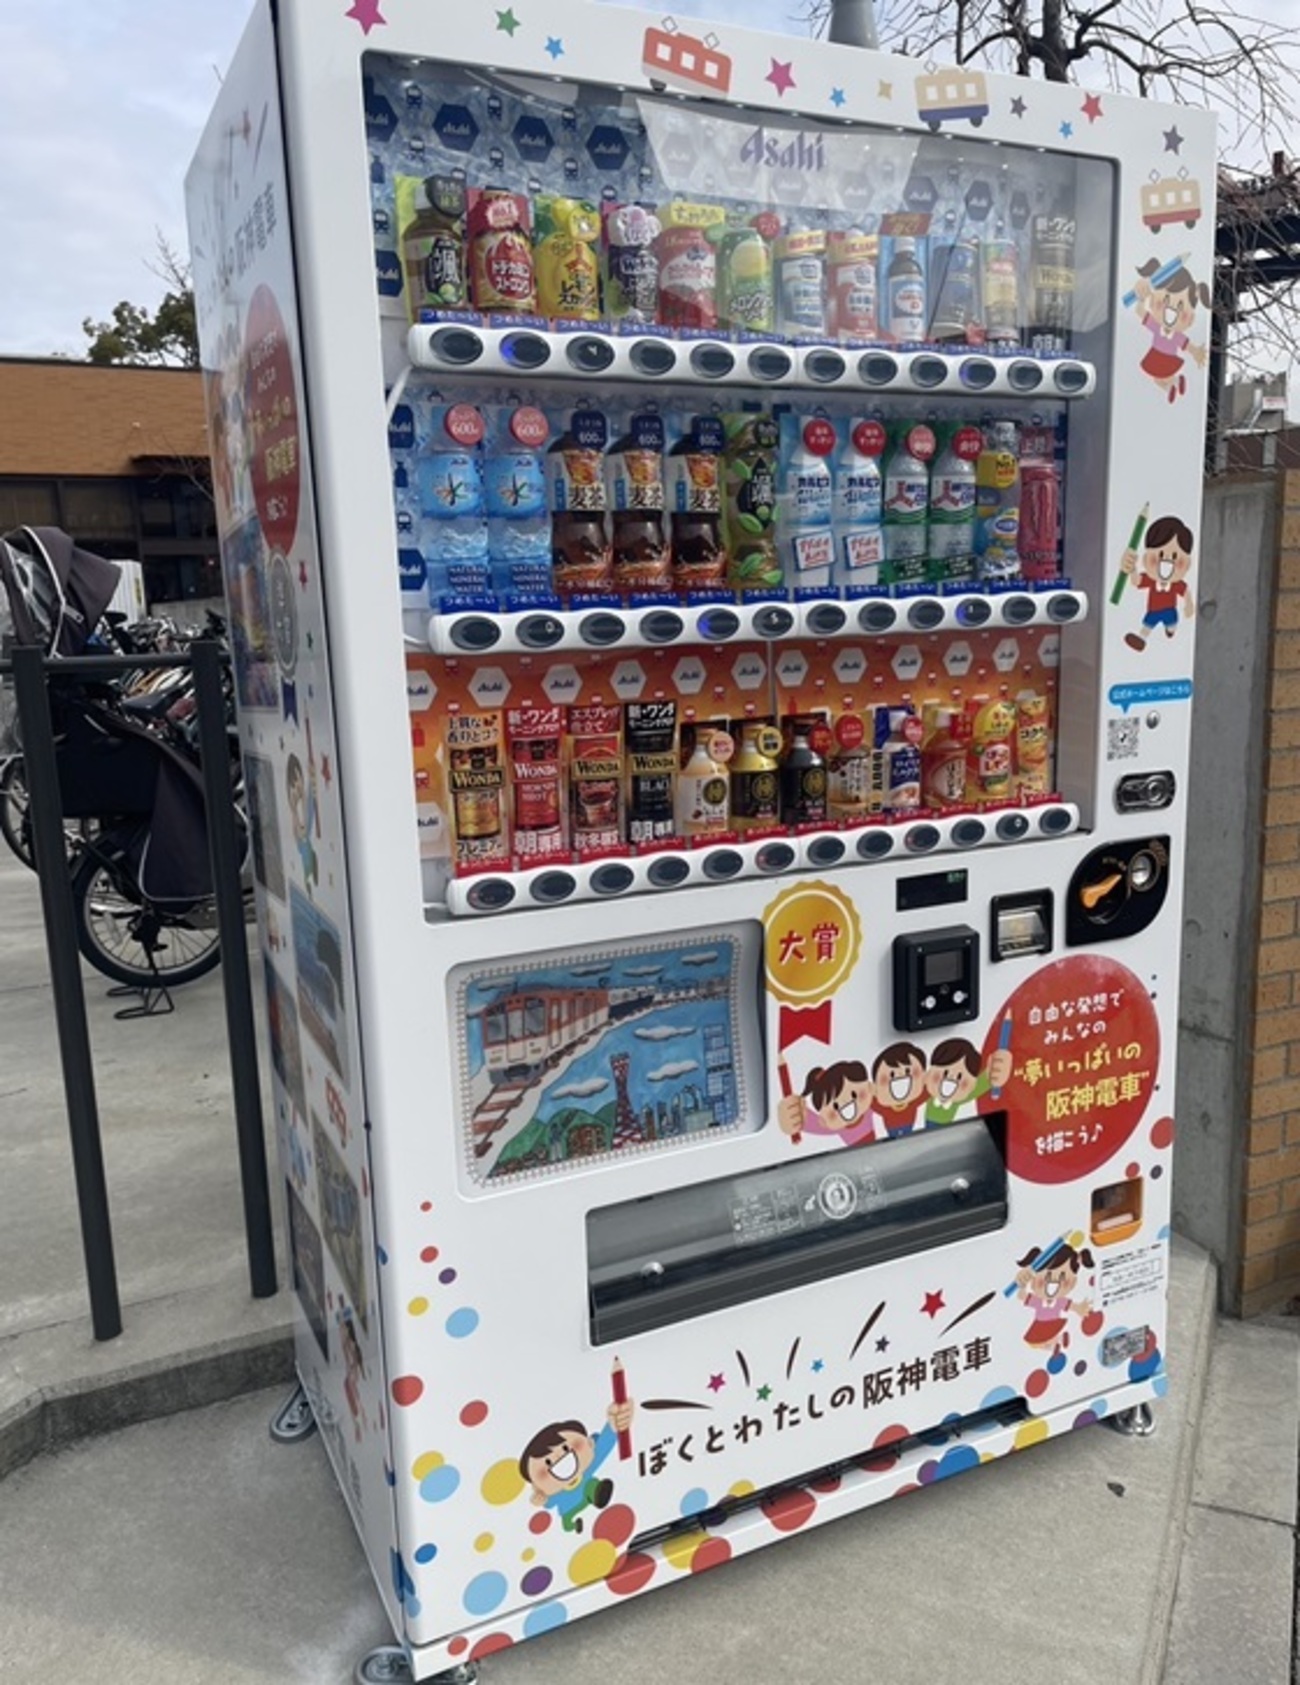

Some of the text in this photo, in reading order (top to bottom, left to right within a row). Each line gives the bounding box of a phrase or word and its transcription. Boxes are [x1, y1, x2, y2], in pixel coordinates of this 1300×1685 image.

[740, 125, 825, 171] Asahi
[779, 923, 842, 965] 大賞
[1028, 988, 1124, 1026] 自由な発想で
[1044, 1020, 1106, 1045] みんなの
